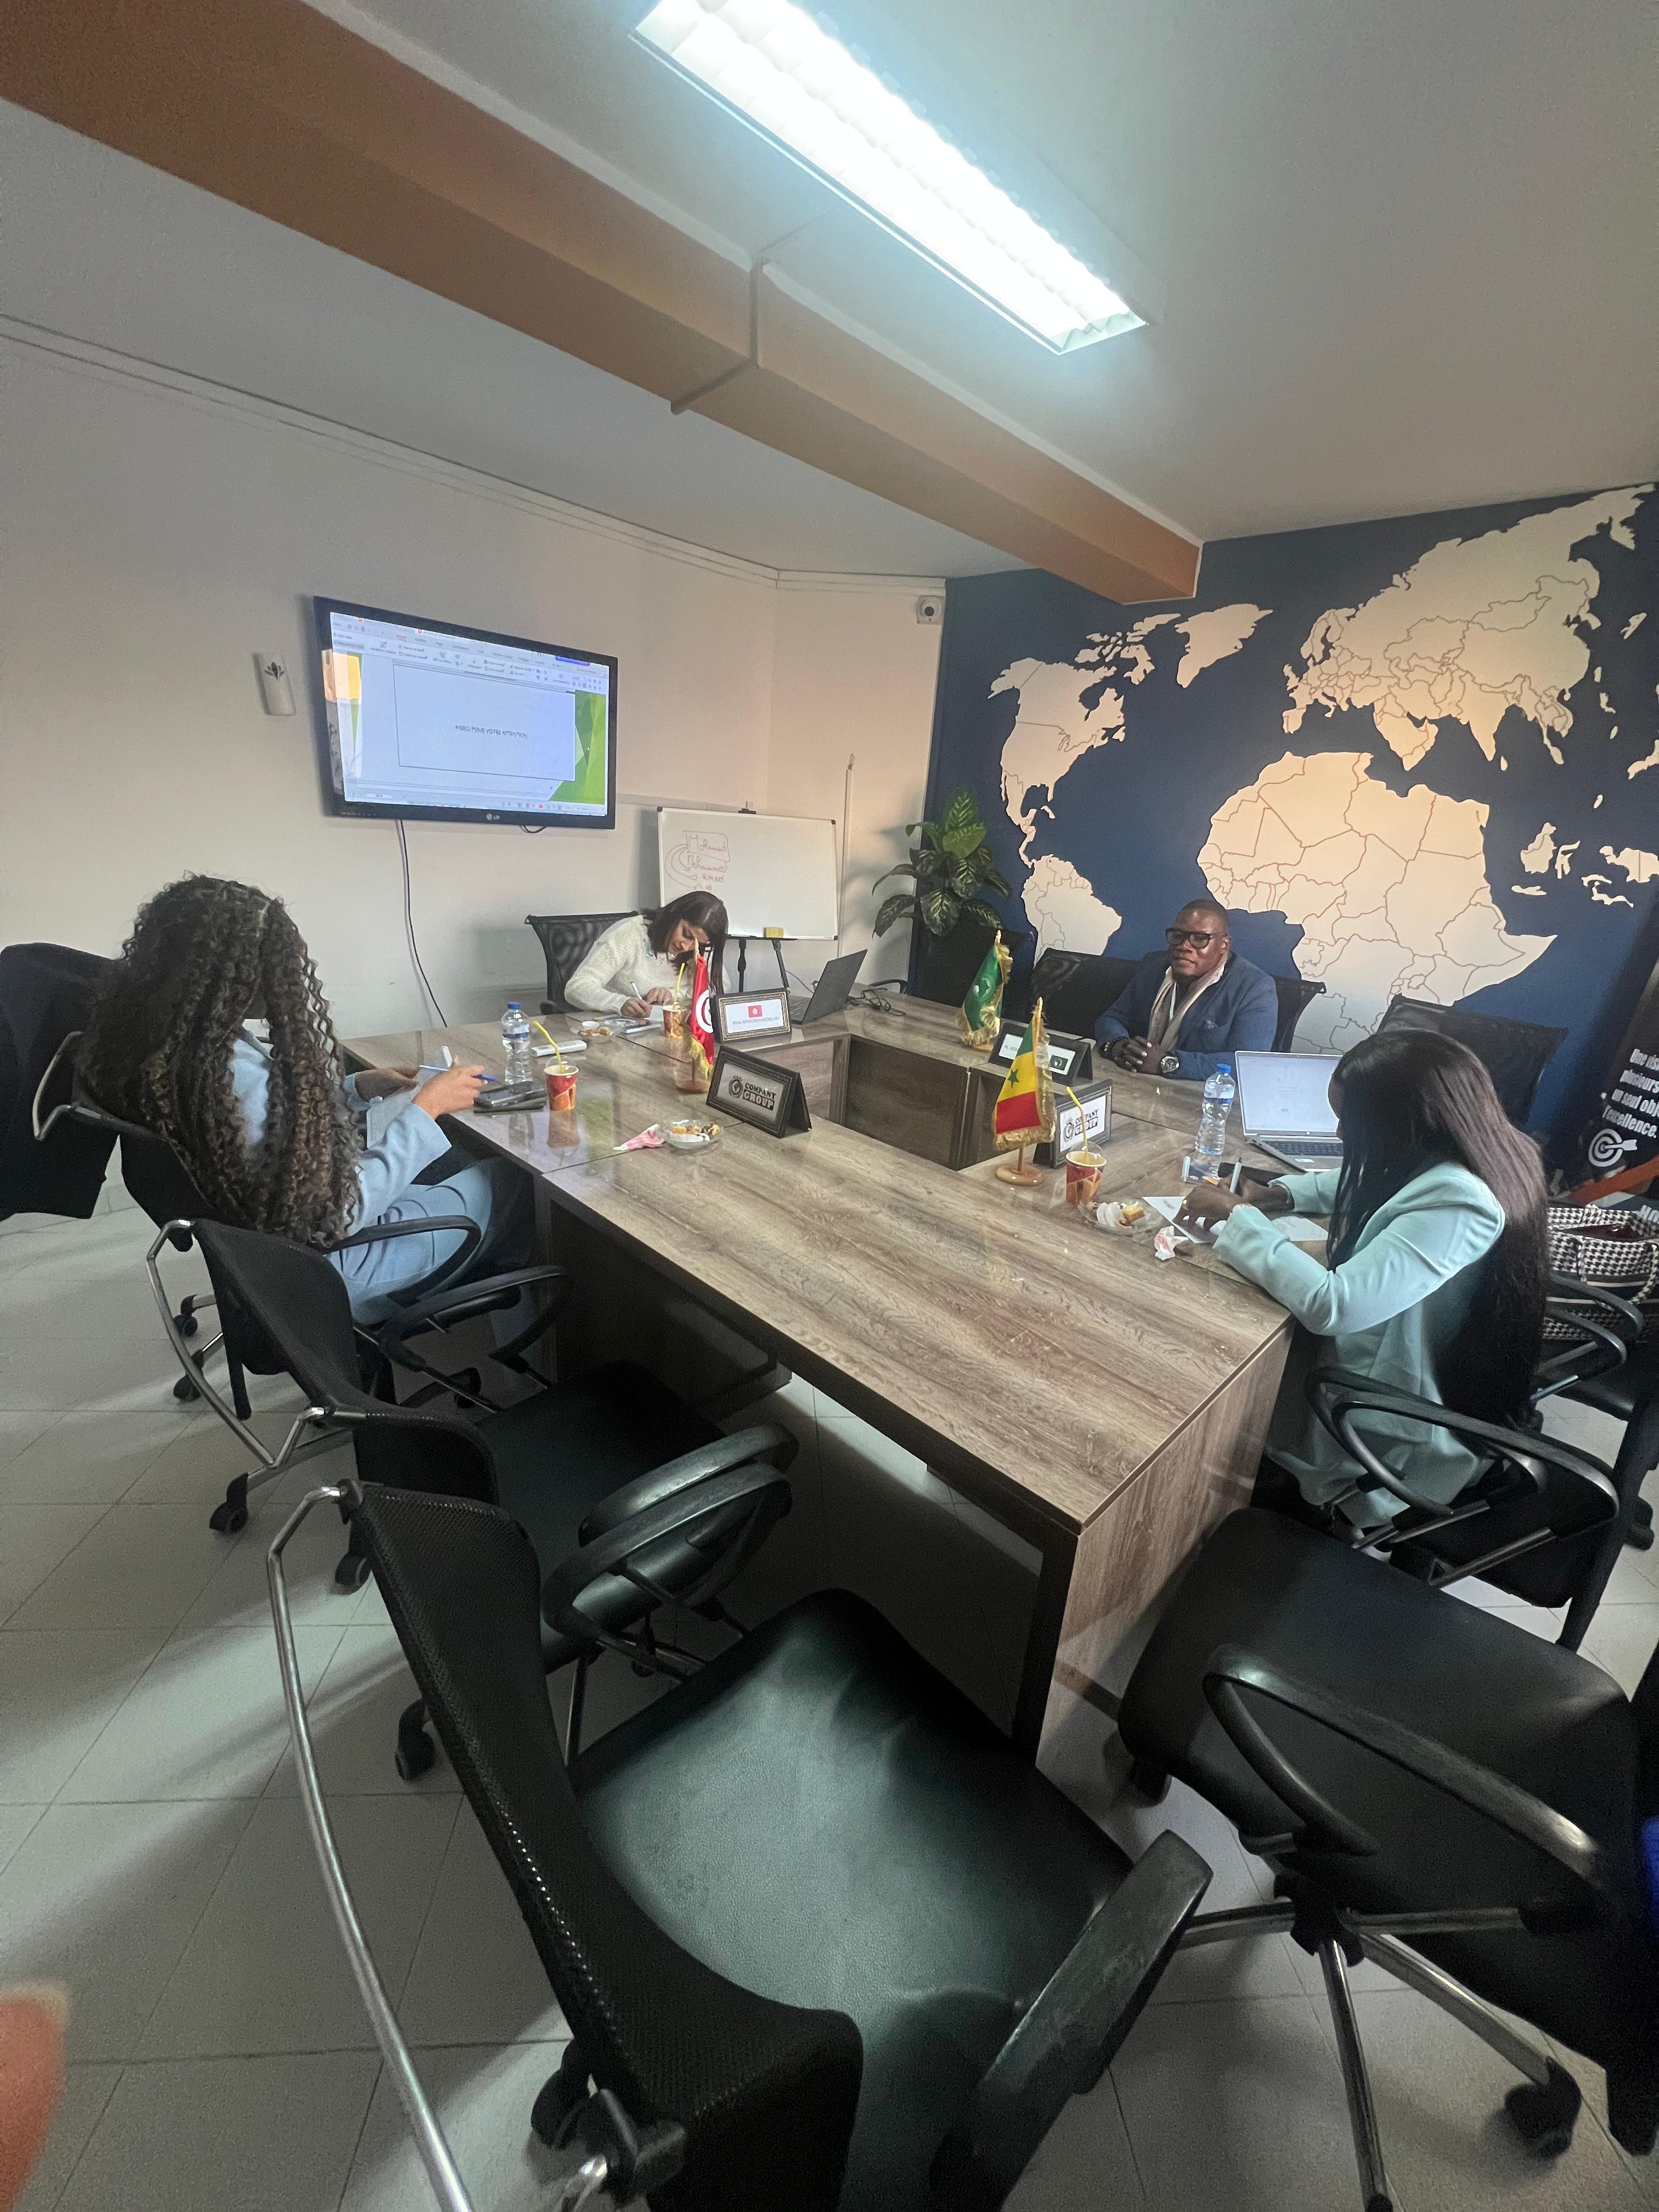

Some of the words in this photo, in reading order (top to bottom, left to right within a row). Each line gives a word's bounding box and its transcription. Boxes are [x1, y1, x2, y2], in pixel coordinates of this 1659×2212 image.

[471, 726, 485, 734] POUR
[502, 730, 528, 740] ATTENTION
[1630, 1048, 1647, 1066] Une
[1620, 1069, 1659, 1093] plusieurs
[745, 1082, 776, 1099] COMPANY
[743, 1090, 774, 1110] GROUP
[1621, 1092, 1643, 1109] seul
[1076, 1108, 1099, 1125] COPANY
